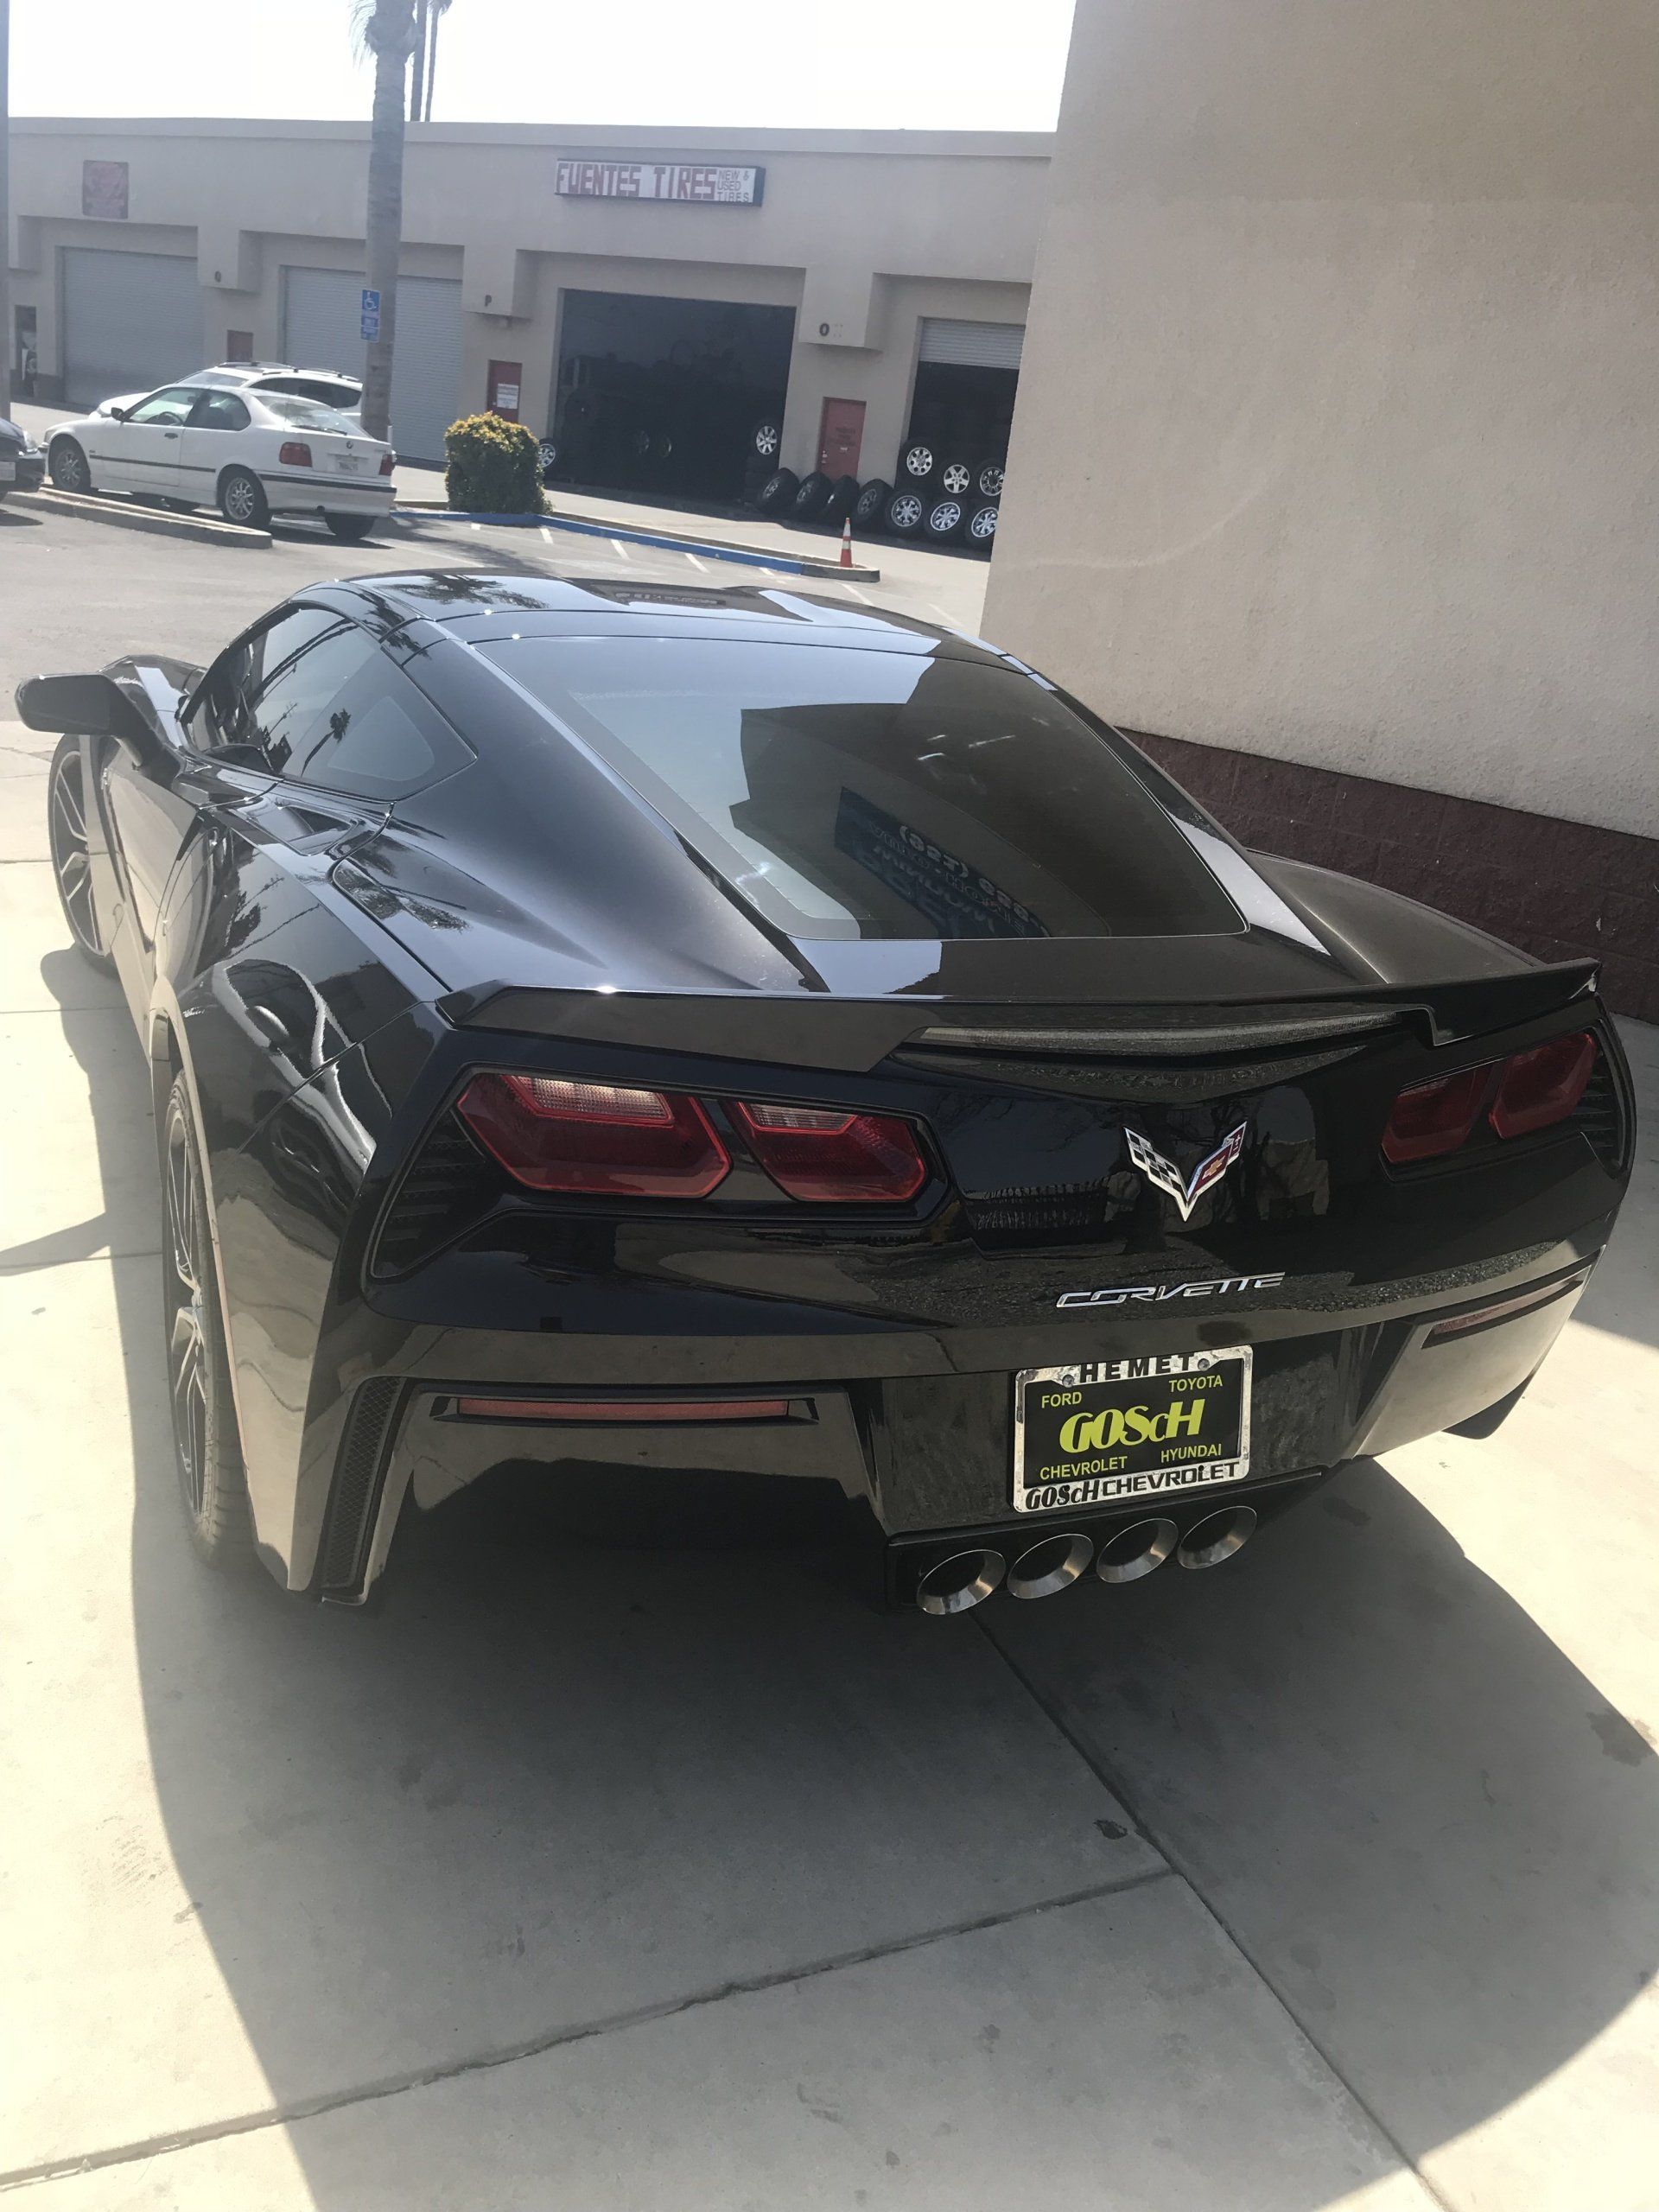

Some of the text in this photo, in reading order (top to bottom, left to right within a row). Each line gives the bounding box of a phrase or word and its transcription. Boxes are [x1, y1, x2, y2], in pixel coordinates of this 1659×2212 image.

[556, 162, 718, 200] FUENTES TIRES
[717, 180, 741, 191] USED
[718, 170, 741, 180] NEW
[717, 192, 750, 203] TIRES
[484, 295, 493, 307] P
[1056, 1272, 1286, 1308] CORVETTE
[1079, 1352, 1196, 1383] HEMET
[1041, 1375, 1224, 1408] FORD TOYOTA
[1039, 1443, 1223, 1481] CHEVROLET HYUNDAI
[1102, 1461, 1240, 1495] CHEVROLET
